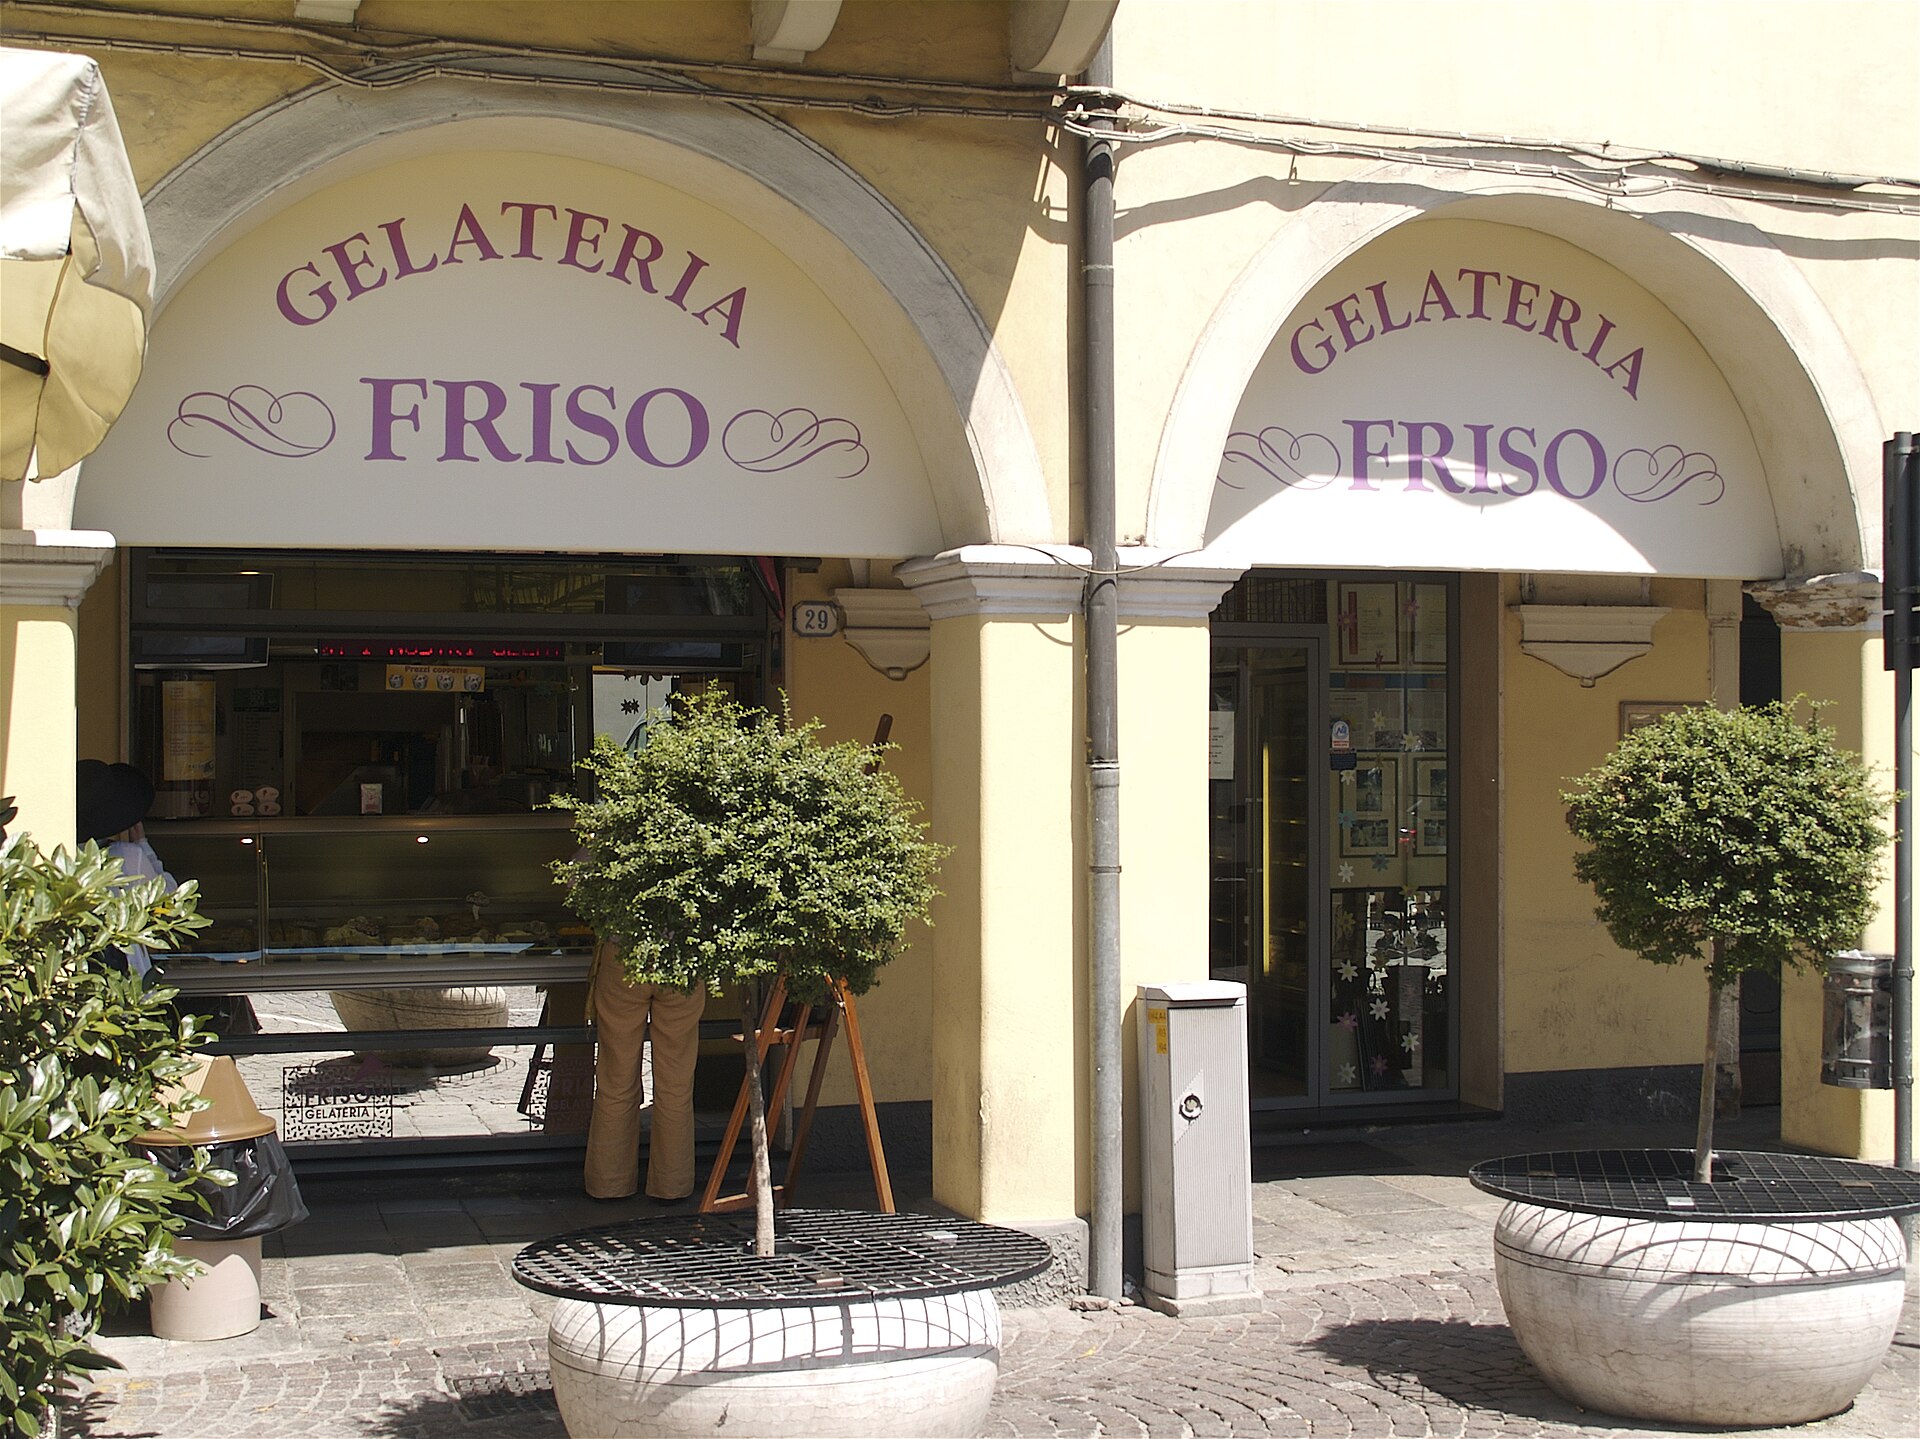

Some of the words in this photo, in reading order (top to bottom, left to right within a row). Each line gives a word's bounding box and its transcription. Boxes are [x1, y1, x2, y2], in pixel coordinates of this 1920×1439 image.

[275, 201, 749, 349] GELATERIA
[1290, 267, 1645, 401] GELATERIA
[359, 376, 711, 469] FRISO
[1341, 418, 1608, 500] FRISO
[805, 609, 828, 631] 29
[404, 665, 430, 673] Prezzi
[304, 1107, 370, 1120] GELATERIA
[305, 1087, 370, 1105] FRISO
